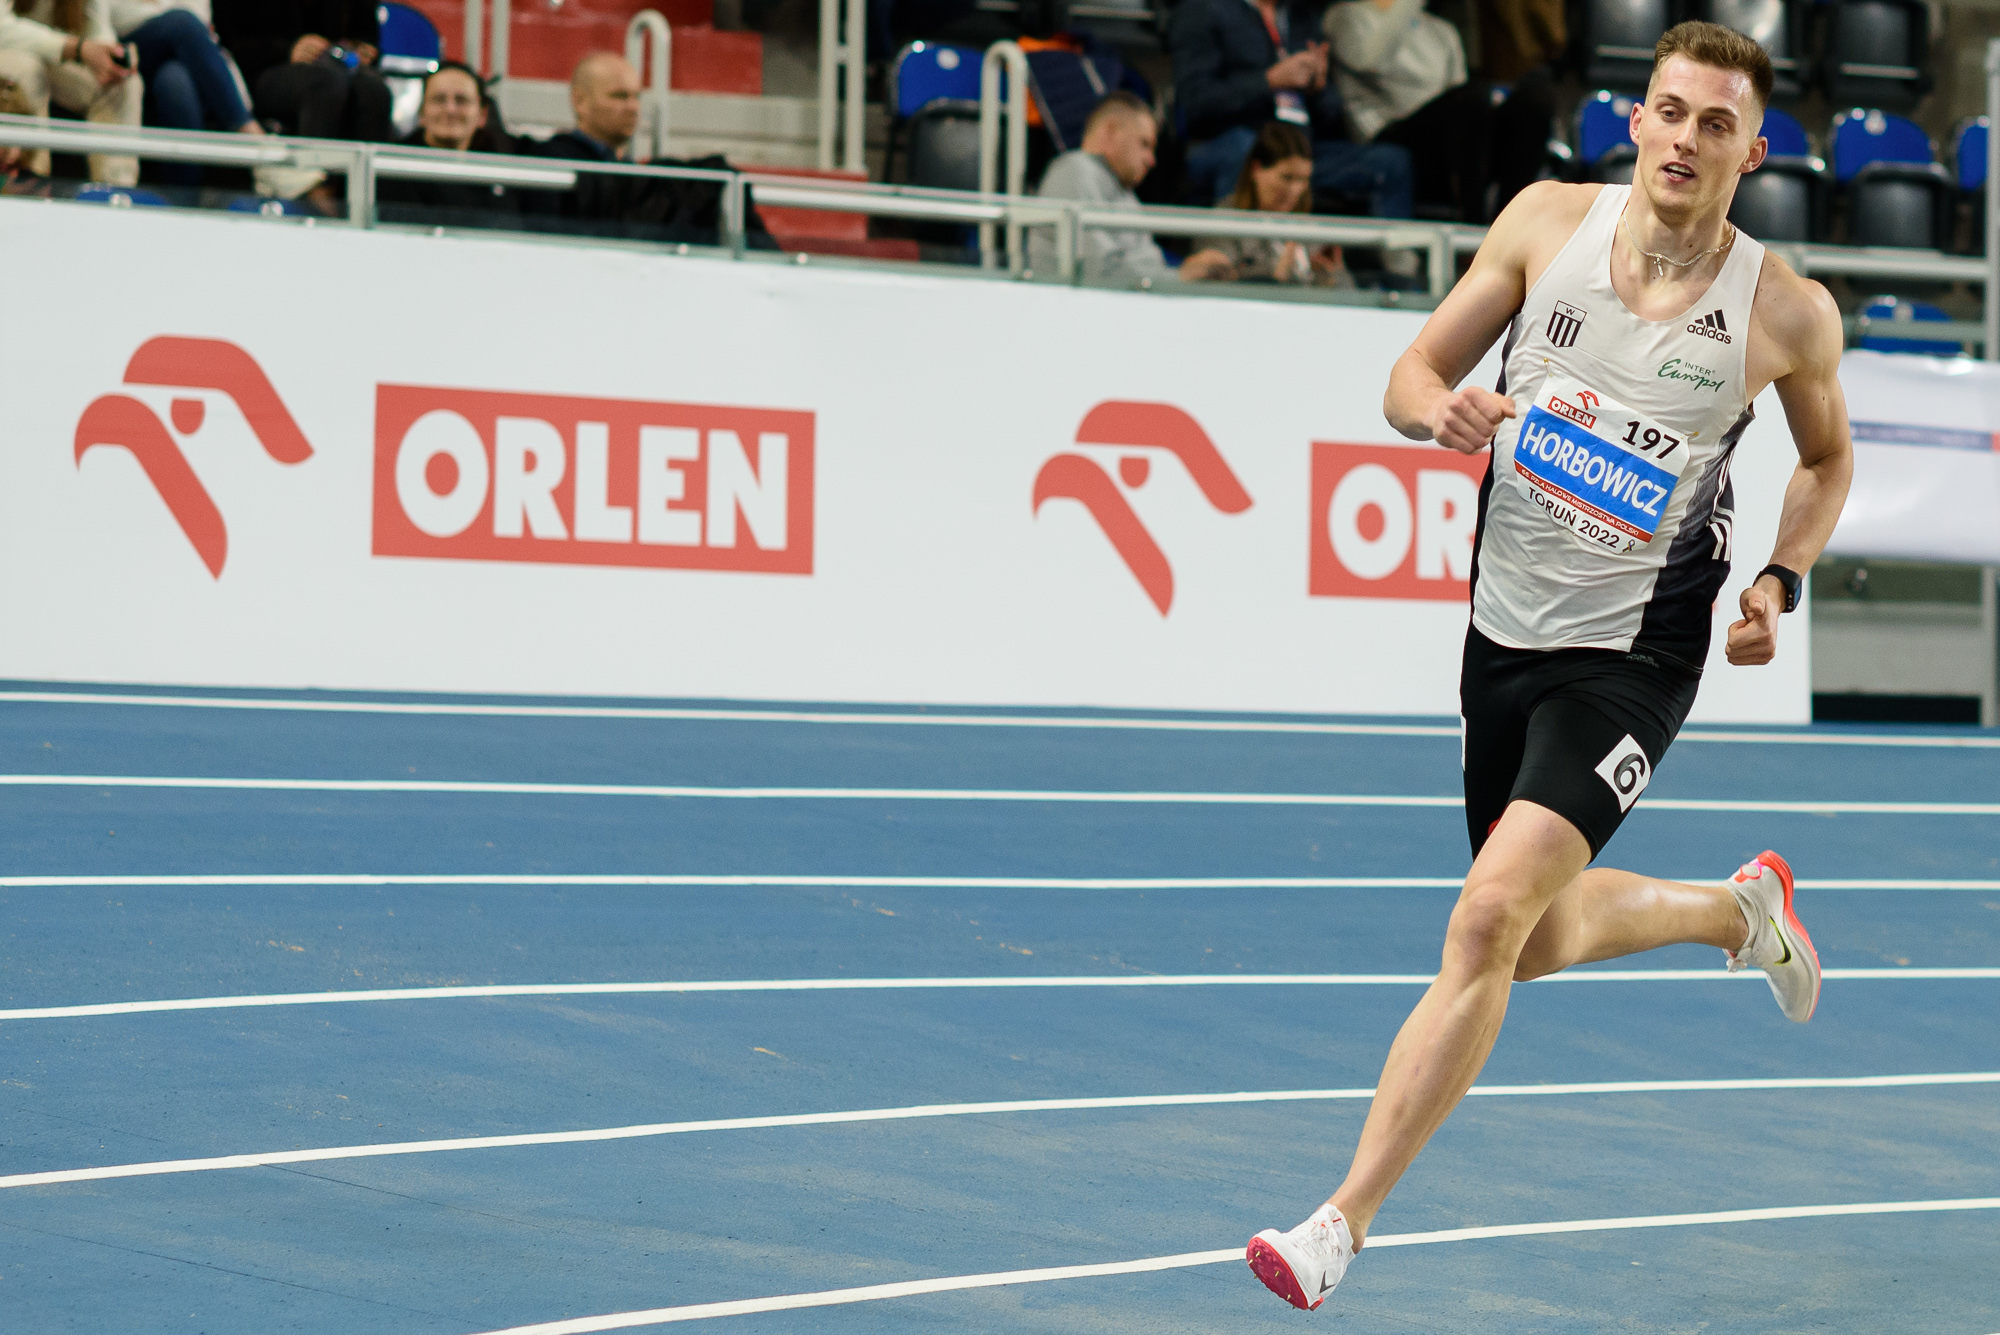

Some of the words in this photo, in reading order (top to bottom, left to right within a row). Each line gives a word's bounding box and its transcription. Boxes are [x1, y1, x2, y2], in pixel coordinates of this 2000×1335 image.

[1565, 307, 1576, 316] W
[1686, 324, 1732, 344] adidas
[1657, 358, 1726, 393] Europol
[1550, 399, 1594, 427] ORLEN
[1621, 420, 1681, 460] 197
[395, 408, 789, 551] ORLEN
[1521, 421, 1668, 517] HORBOWICZ
[1528, 486, 1577, 527] TORUŃ
[1577, 519, 1620, 549] 2022
[1545, 484, 1572, 501] HALOWE
[1571, 498, 1615, 526] MISTRZOSTWA
[1615, 520, 1640, 536] POLSKI
[1613, 752, 1646, 795] 6
